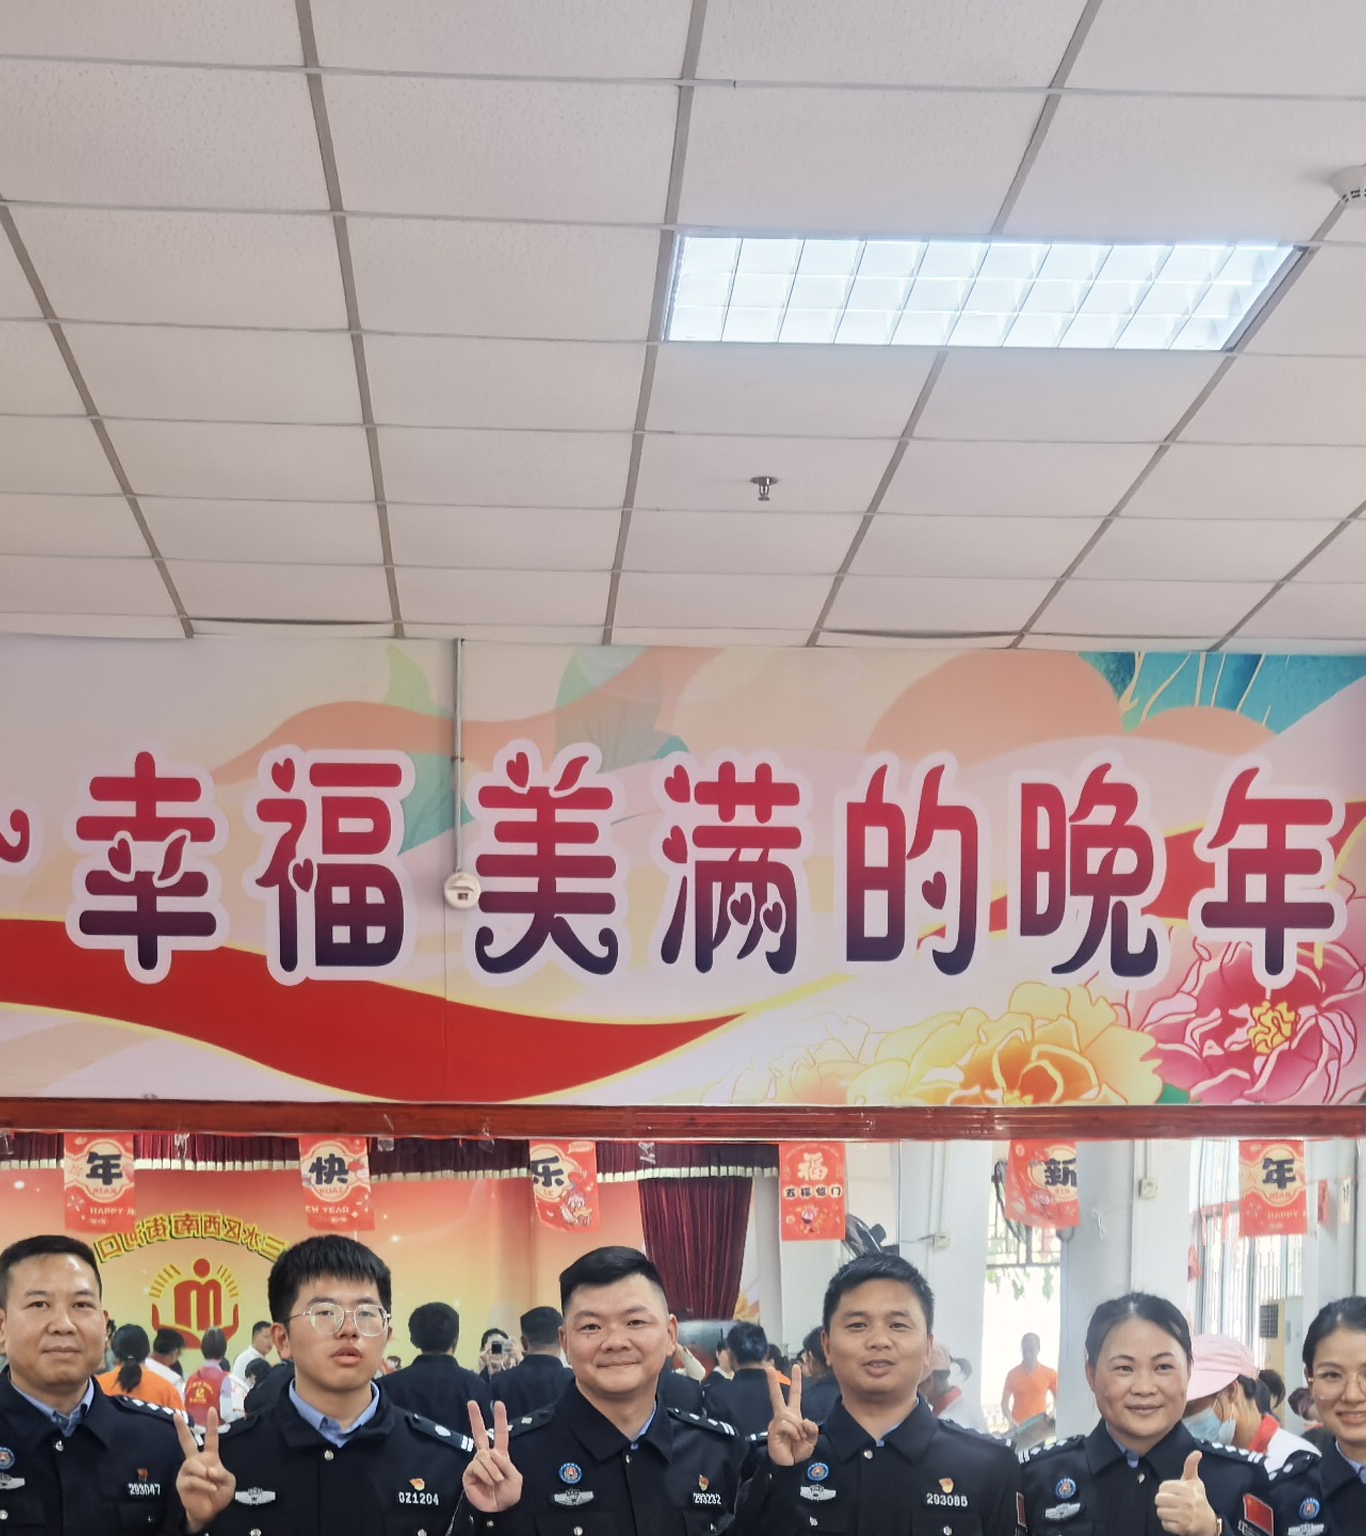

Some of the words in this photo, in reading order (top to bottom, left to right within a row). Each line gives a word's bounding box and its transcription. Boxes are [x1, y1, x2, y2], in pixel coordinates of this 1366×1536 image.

[86, 1152, 123, 1185] 年
[308, 1153, 349, 1185] 快
[531, 1154, 565, 1188] 乐
[797, 1151, 829, 1181] 福
[1043, 1158, 1078, 1188] 新
[1262, 1157, 1297, 1190] 年
